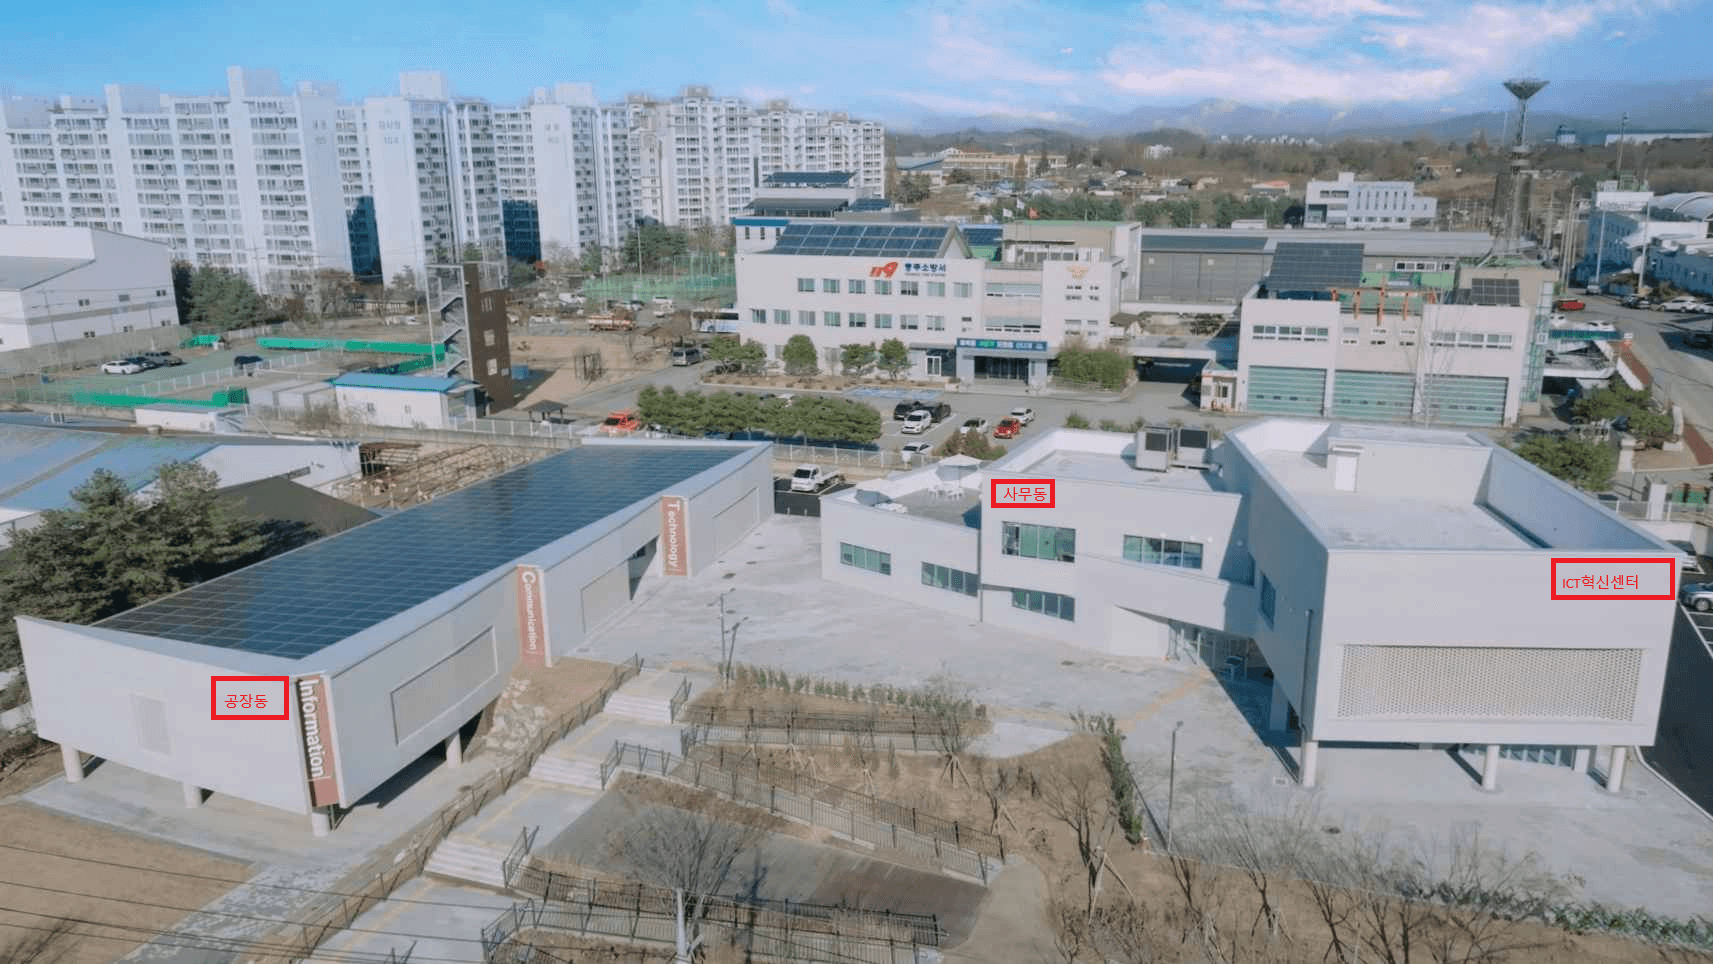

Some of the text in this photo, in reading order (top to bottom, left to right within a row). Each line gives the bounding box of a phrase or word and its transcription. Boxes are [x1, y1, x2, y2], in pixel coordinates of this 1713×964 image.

[667, 500, 680, 568] Technology
[522, 571, 538, 650] Communication
[299, 678, 325, 778] Information
